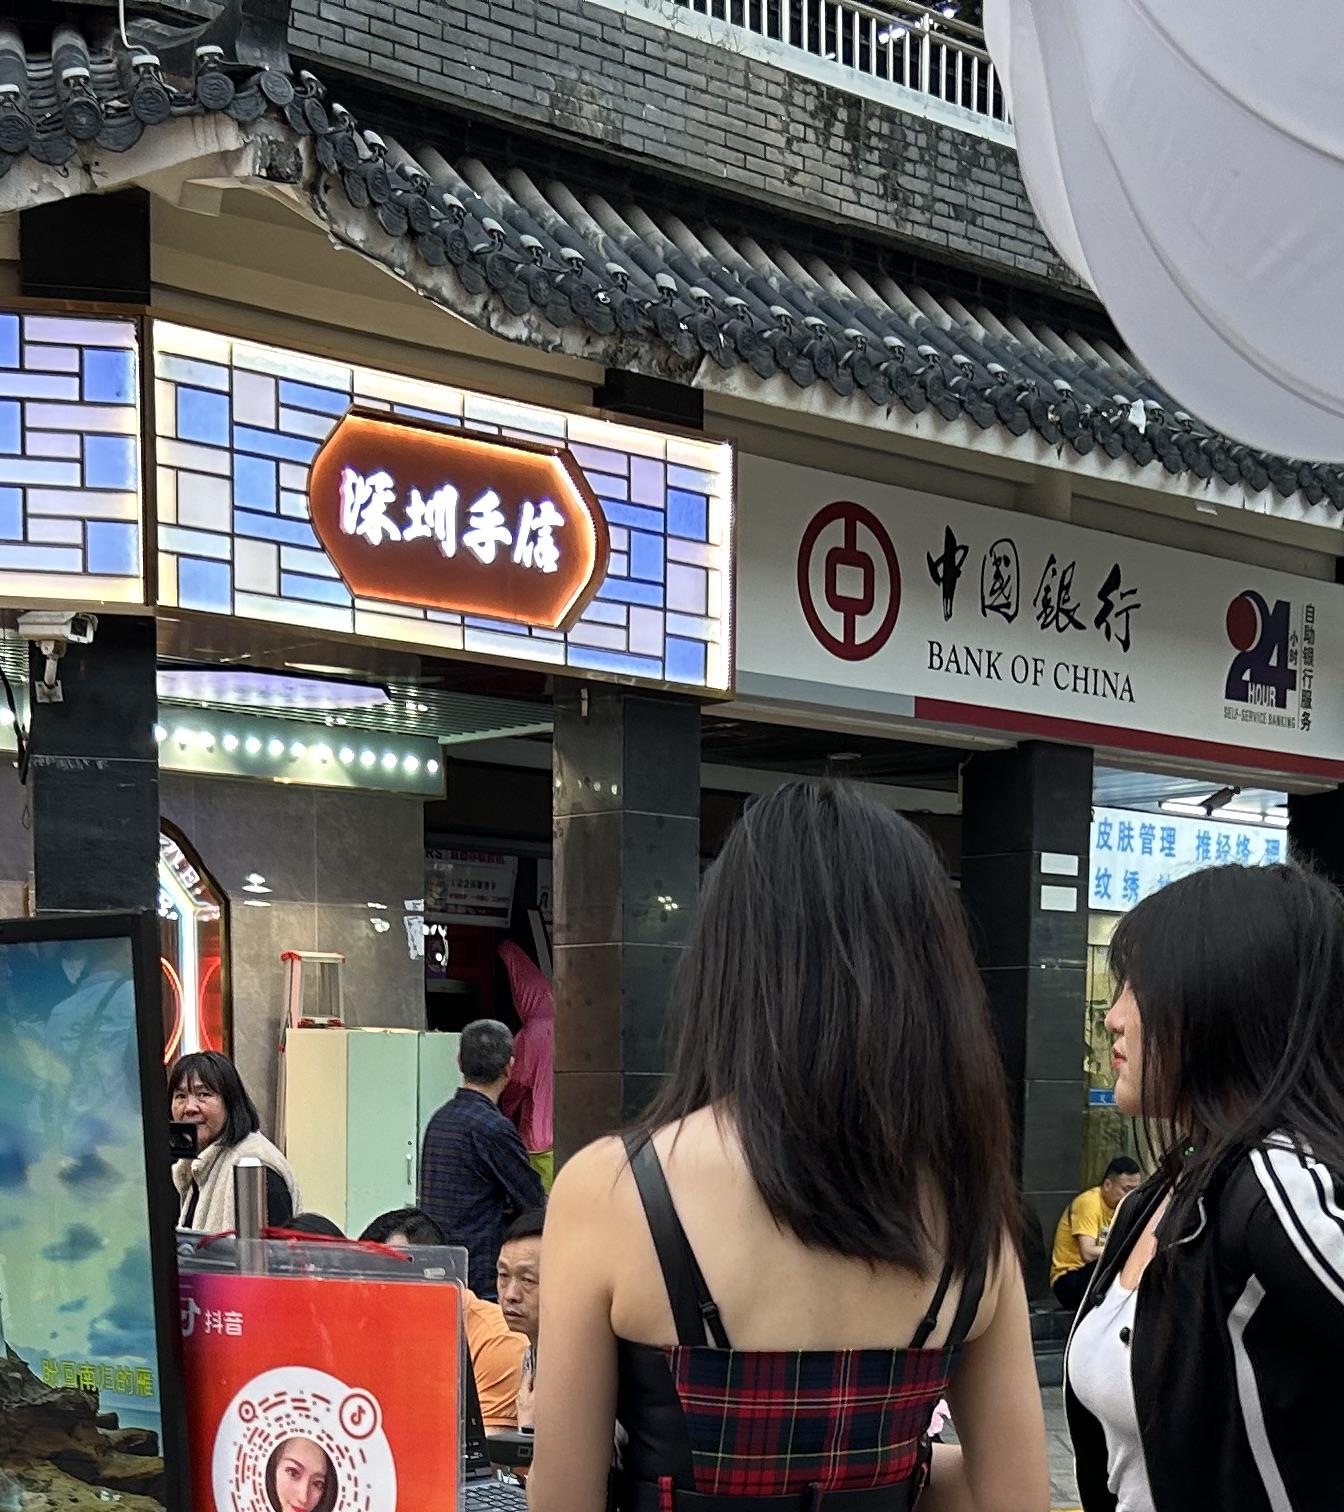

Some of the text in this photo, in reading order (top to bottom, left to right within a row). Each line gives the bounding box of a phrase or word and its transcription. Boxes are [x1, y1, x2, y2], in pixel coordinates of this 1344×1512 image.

[339, 468, 566, 573] 深圳手信
[926, 525, 1142, 653] 中國銀行
[927, 639, 1136, 703] BANK OF CHINA
[1225, 589, 1298, 710] 24
[1300, 602, 1316, 732] 自助银行服务
[1247, 681, 1278, 707] HOUR
[1268, 710, 1296, 729] BANKING
[1095, 817, 1177, 858] 皮肤管理
[204, 1309, 245, 1337] 抖音
